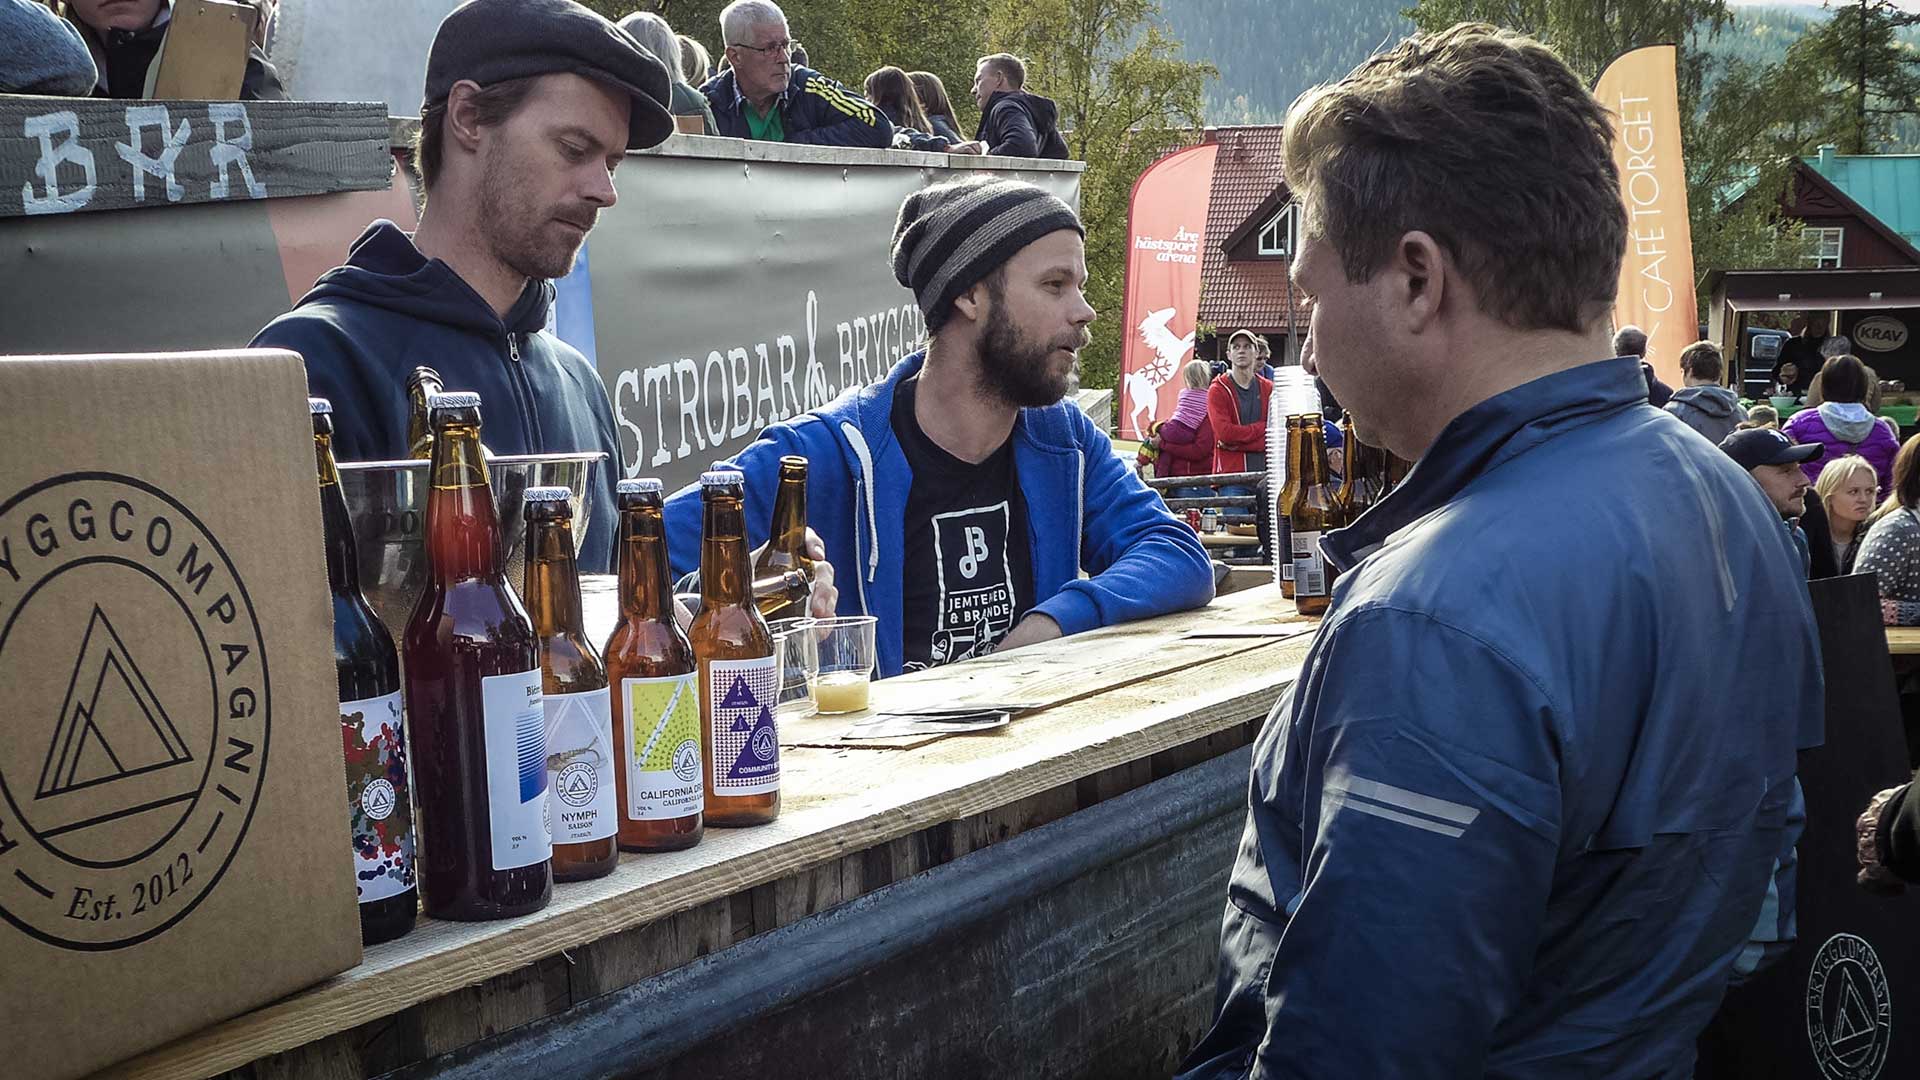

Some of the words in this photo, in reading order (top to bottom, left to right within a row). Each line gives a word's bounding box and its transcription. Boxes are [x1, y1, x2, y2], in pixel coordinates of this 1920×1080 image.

[22, 103, 268, 215] BAR
[1173, 225, 1199, 241] Åre
[1135, 236, 1198, 253] hästsport
[1156, 252, 1196, 264] arena
[1860, 326, 1903, 342] KRAV
[950, 612, 959, 624] &
[640, 785, 694, 800] CALIFORNIA
[561, 809, 598, 822] NYMPH
[568, 821, 593, 830] SAISON
[64, 886, 122, 921] Est.
[131, 852, 194, 915] 2012
